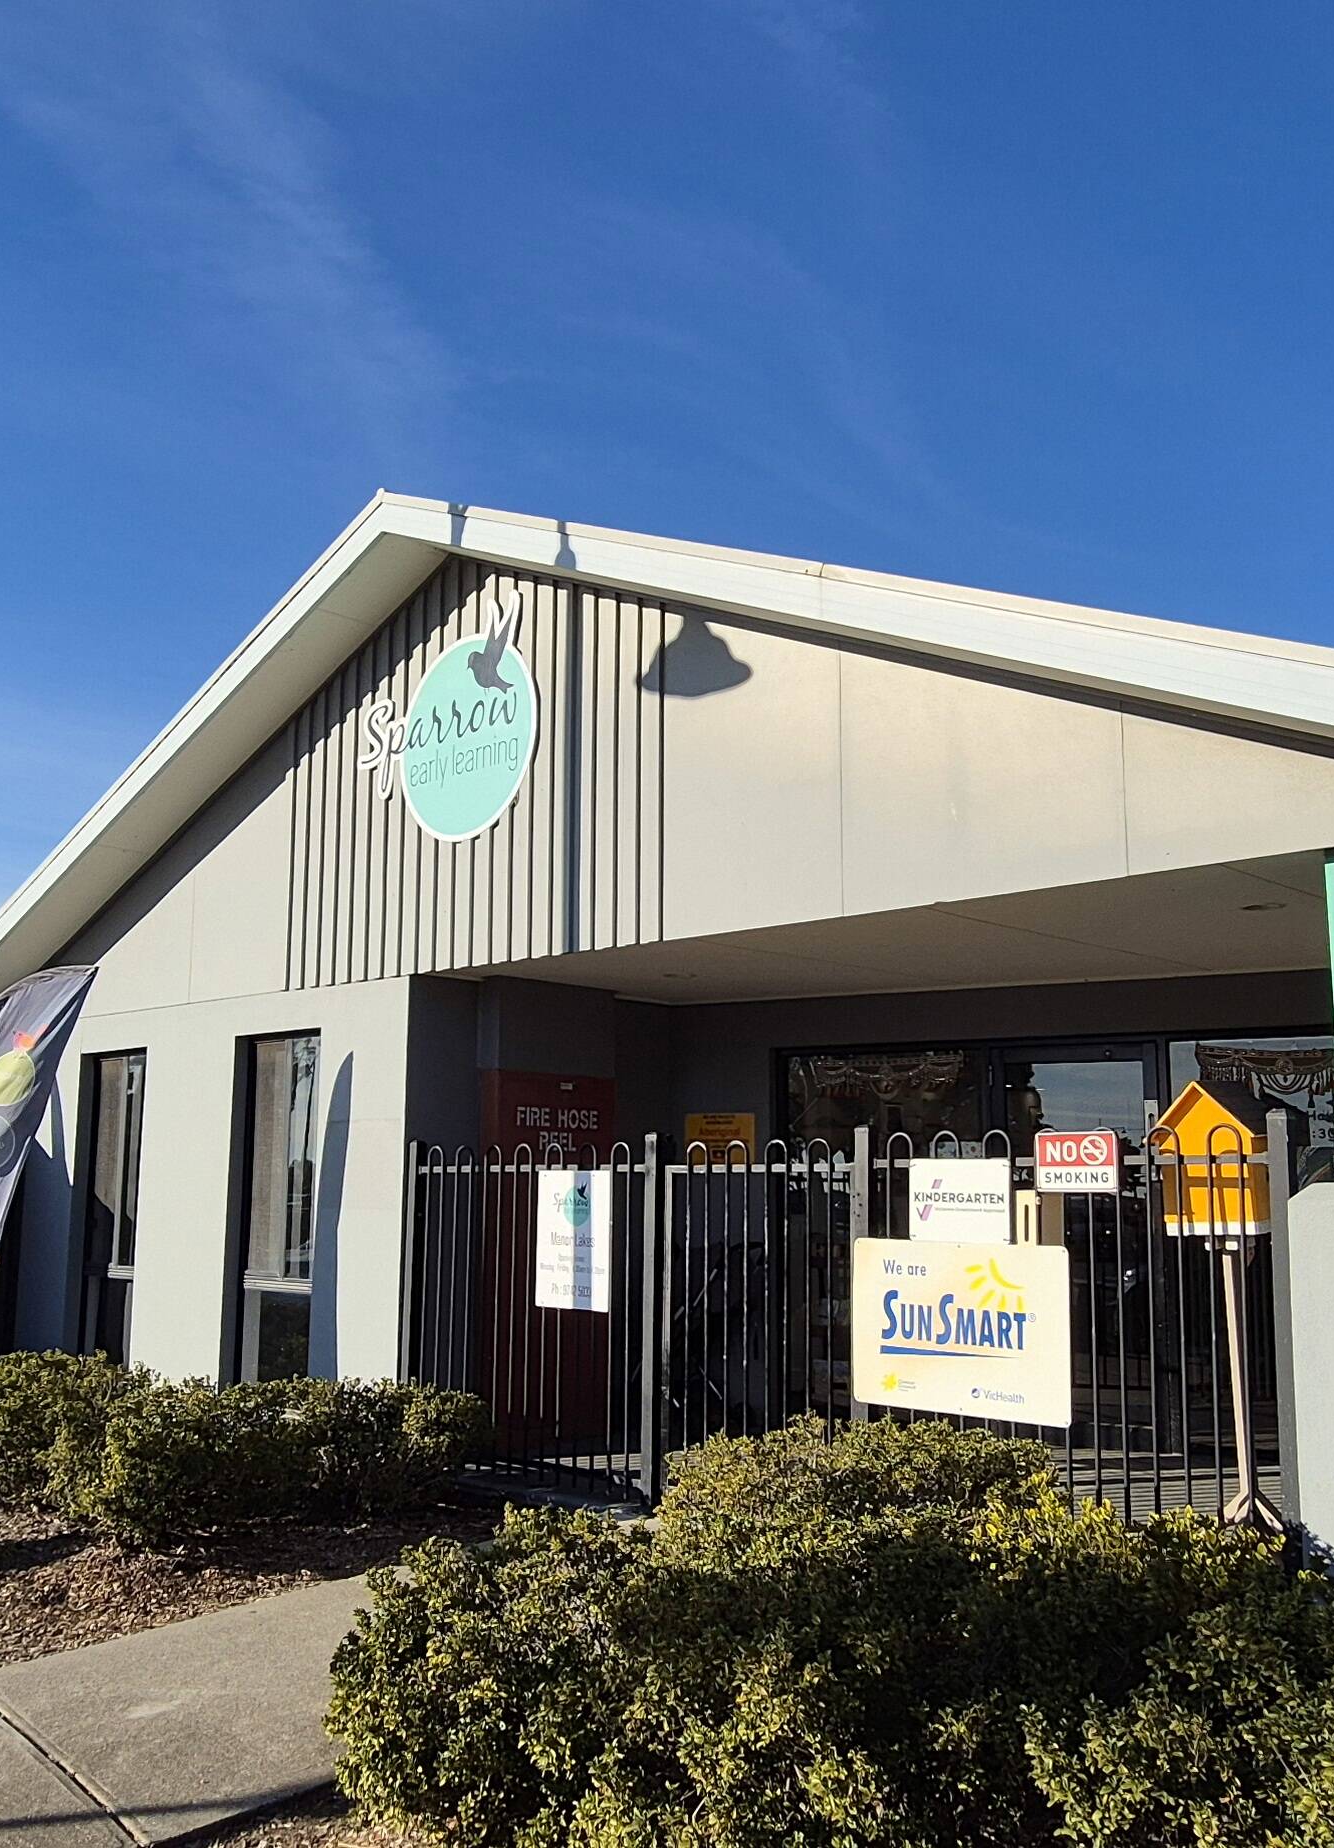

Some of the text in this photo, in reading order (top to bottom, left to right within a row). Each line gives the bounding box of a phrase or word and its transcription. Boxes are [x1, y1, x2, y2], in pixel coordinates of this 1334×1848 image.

[360, 692, 517, 793] Sparrow
[410, 737, 519, 789] early learning
[516, 1106, 599, 1130] FIRE HOSE
[539, 1131, 577, 1152] REEL
[1046, 1140, 1078, 1163] NO
[1045, 1171, 1109, 1184] SMOKING
[913, 1191, 1005, 1204] KINDERGARTEN
[550, 1231, 596, 1248] Manor Lakes
[883, 1258, 927, 1277] We are
[983, 1388, 1025, 1405] VicHealth
